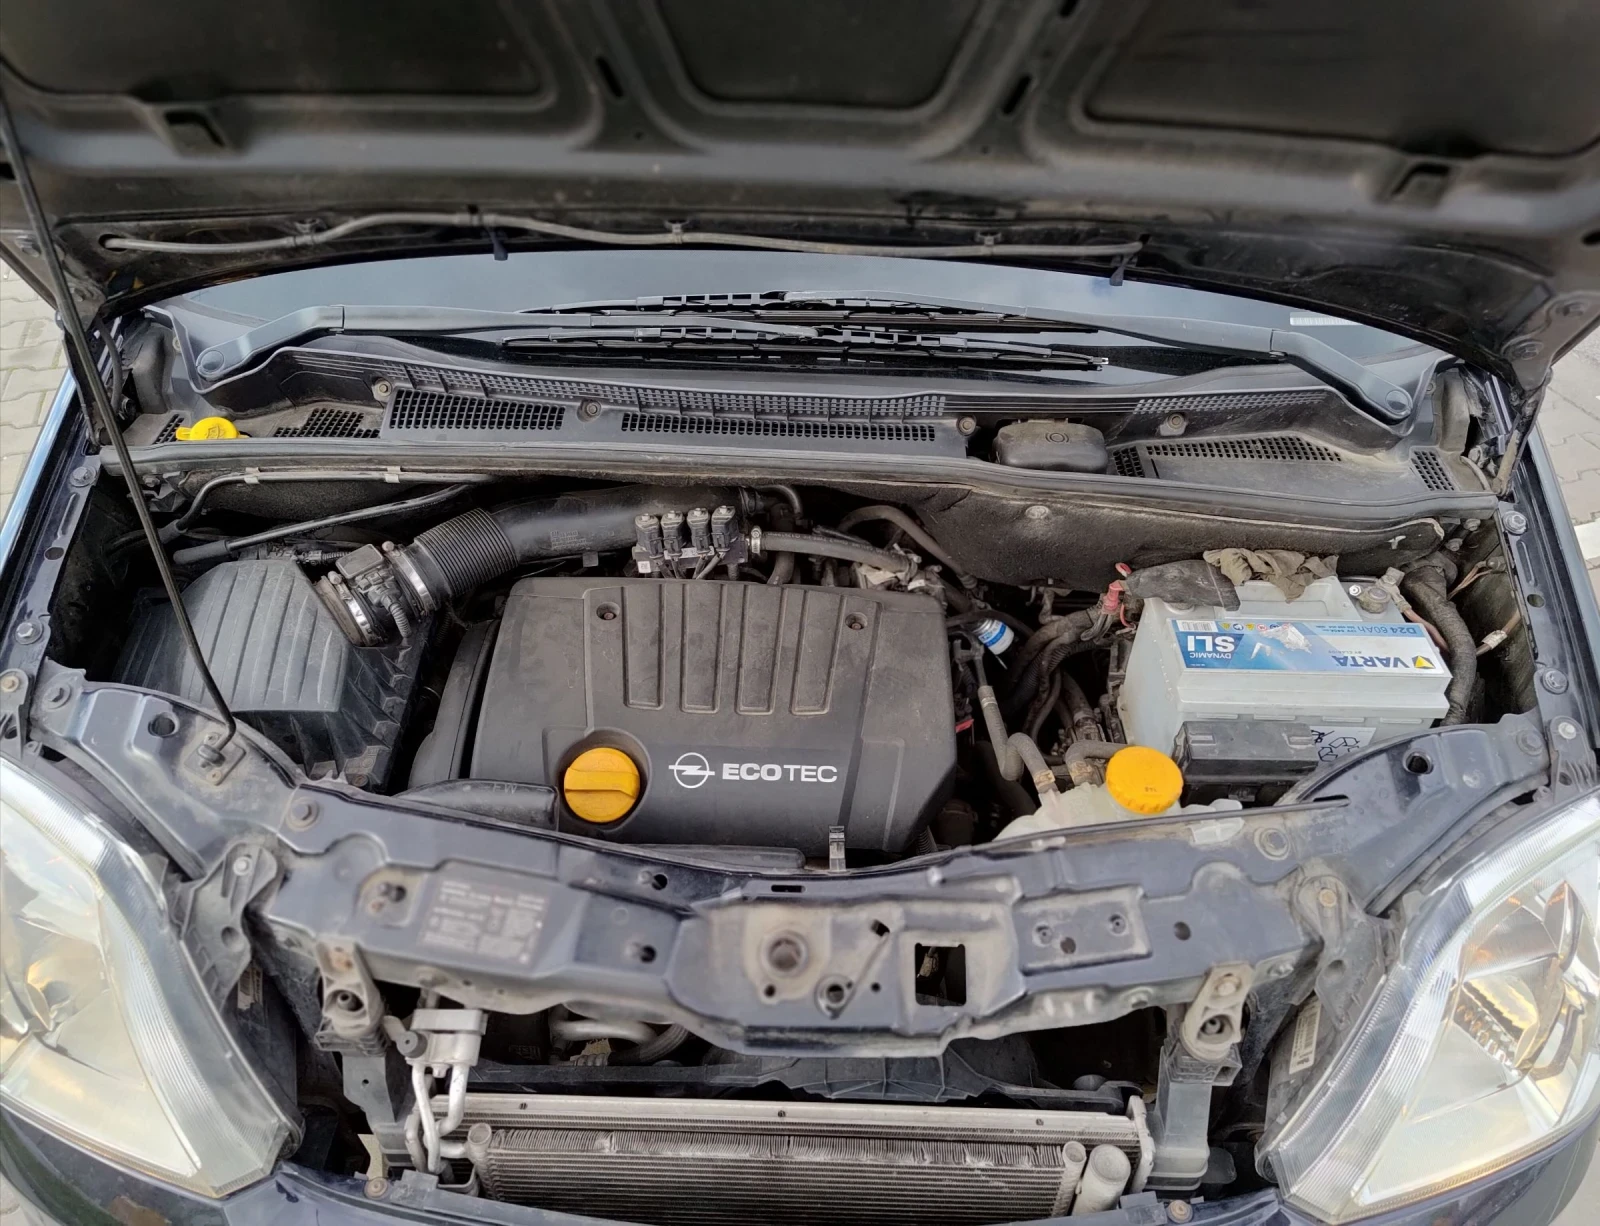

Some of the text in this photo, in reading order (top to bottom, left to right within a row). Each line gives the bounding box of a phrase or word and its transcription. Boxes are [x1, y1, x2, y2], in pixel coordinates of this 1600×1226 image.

[1357, 626, 1388, 635] 60Ah
[1390, 626, 1417, 635] D24
[1187, 635, 1235, 653] SLI
[1331, 655, 1410, 669] VARTA
[722, 763, 838, 783] ECOTEC
